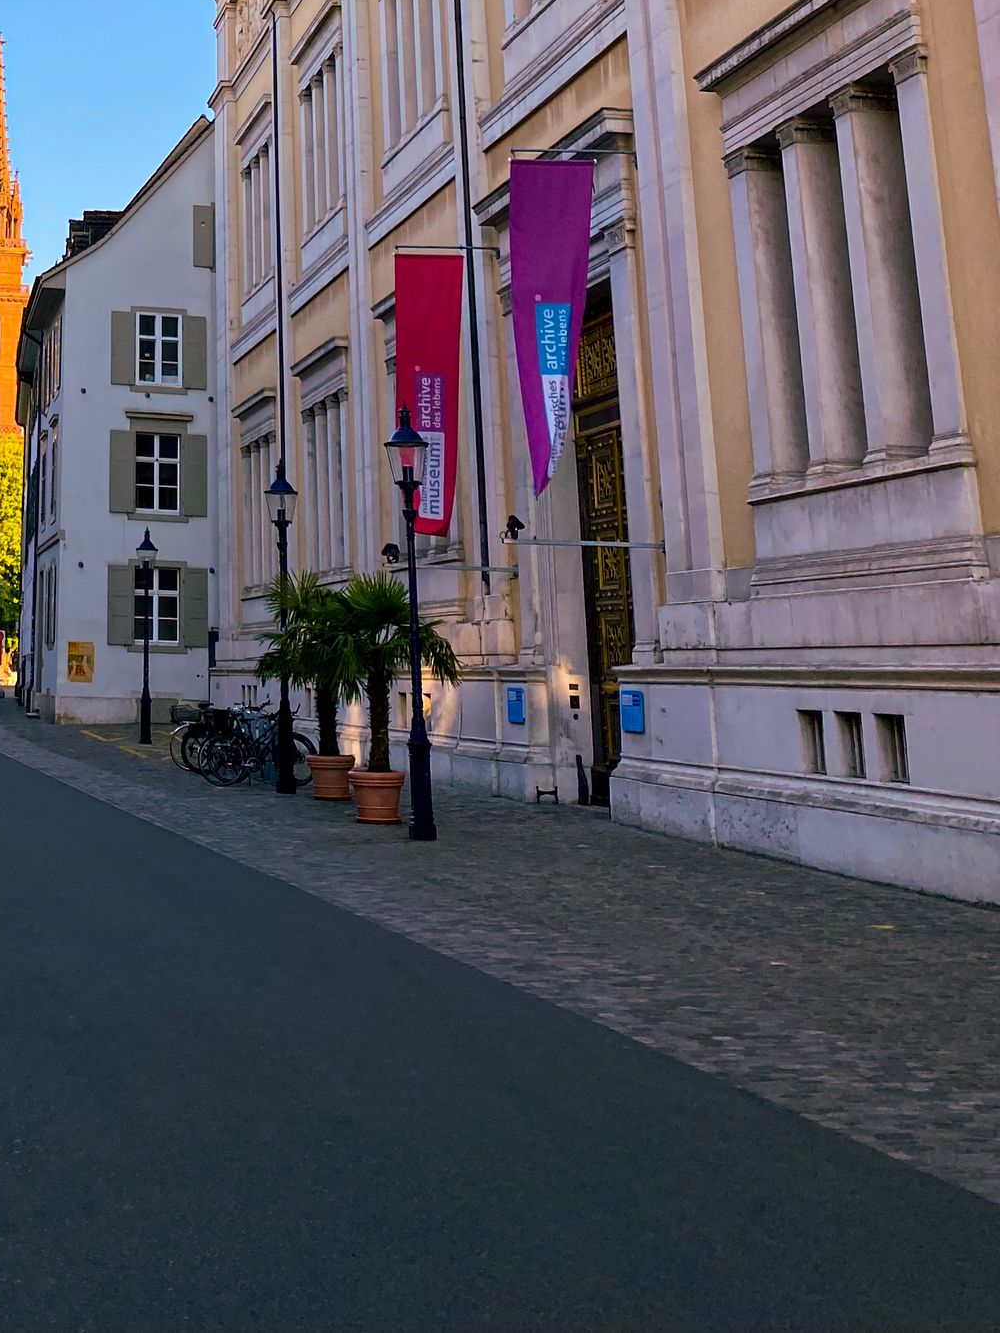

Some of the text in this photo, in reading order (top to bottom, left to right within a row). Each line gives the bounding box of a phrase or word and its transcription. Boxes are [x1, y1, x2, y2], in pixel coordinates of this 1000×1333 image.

[540, 309, 558, 370] archive
[557, 309, 567, 346] lebens
[418, 377, 431, 428] archive
[432, 377, 441, 409] lebens
[432, 412, 441, 428] des
[429, 442, 441, 515] museum
